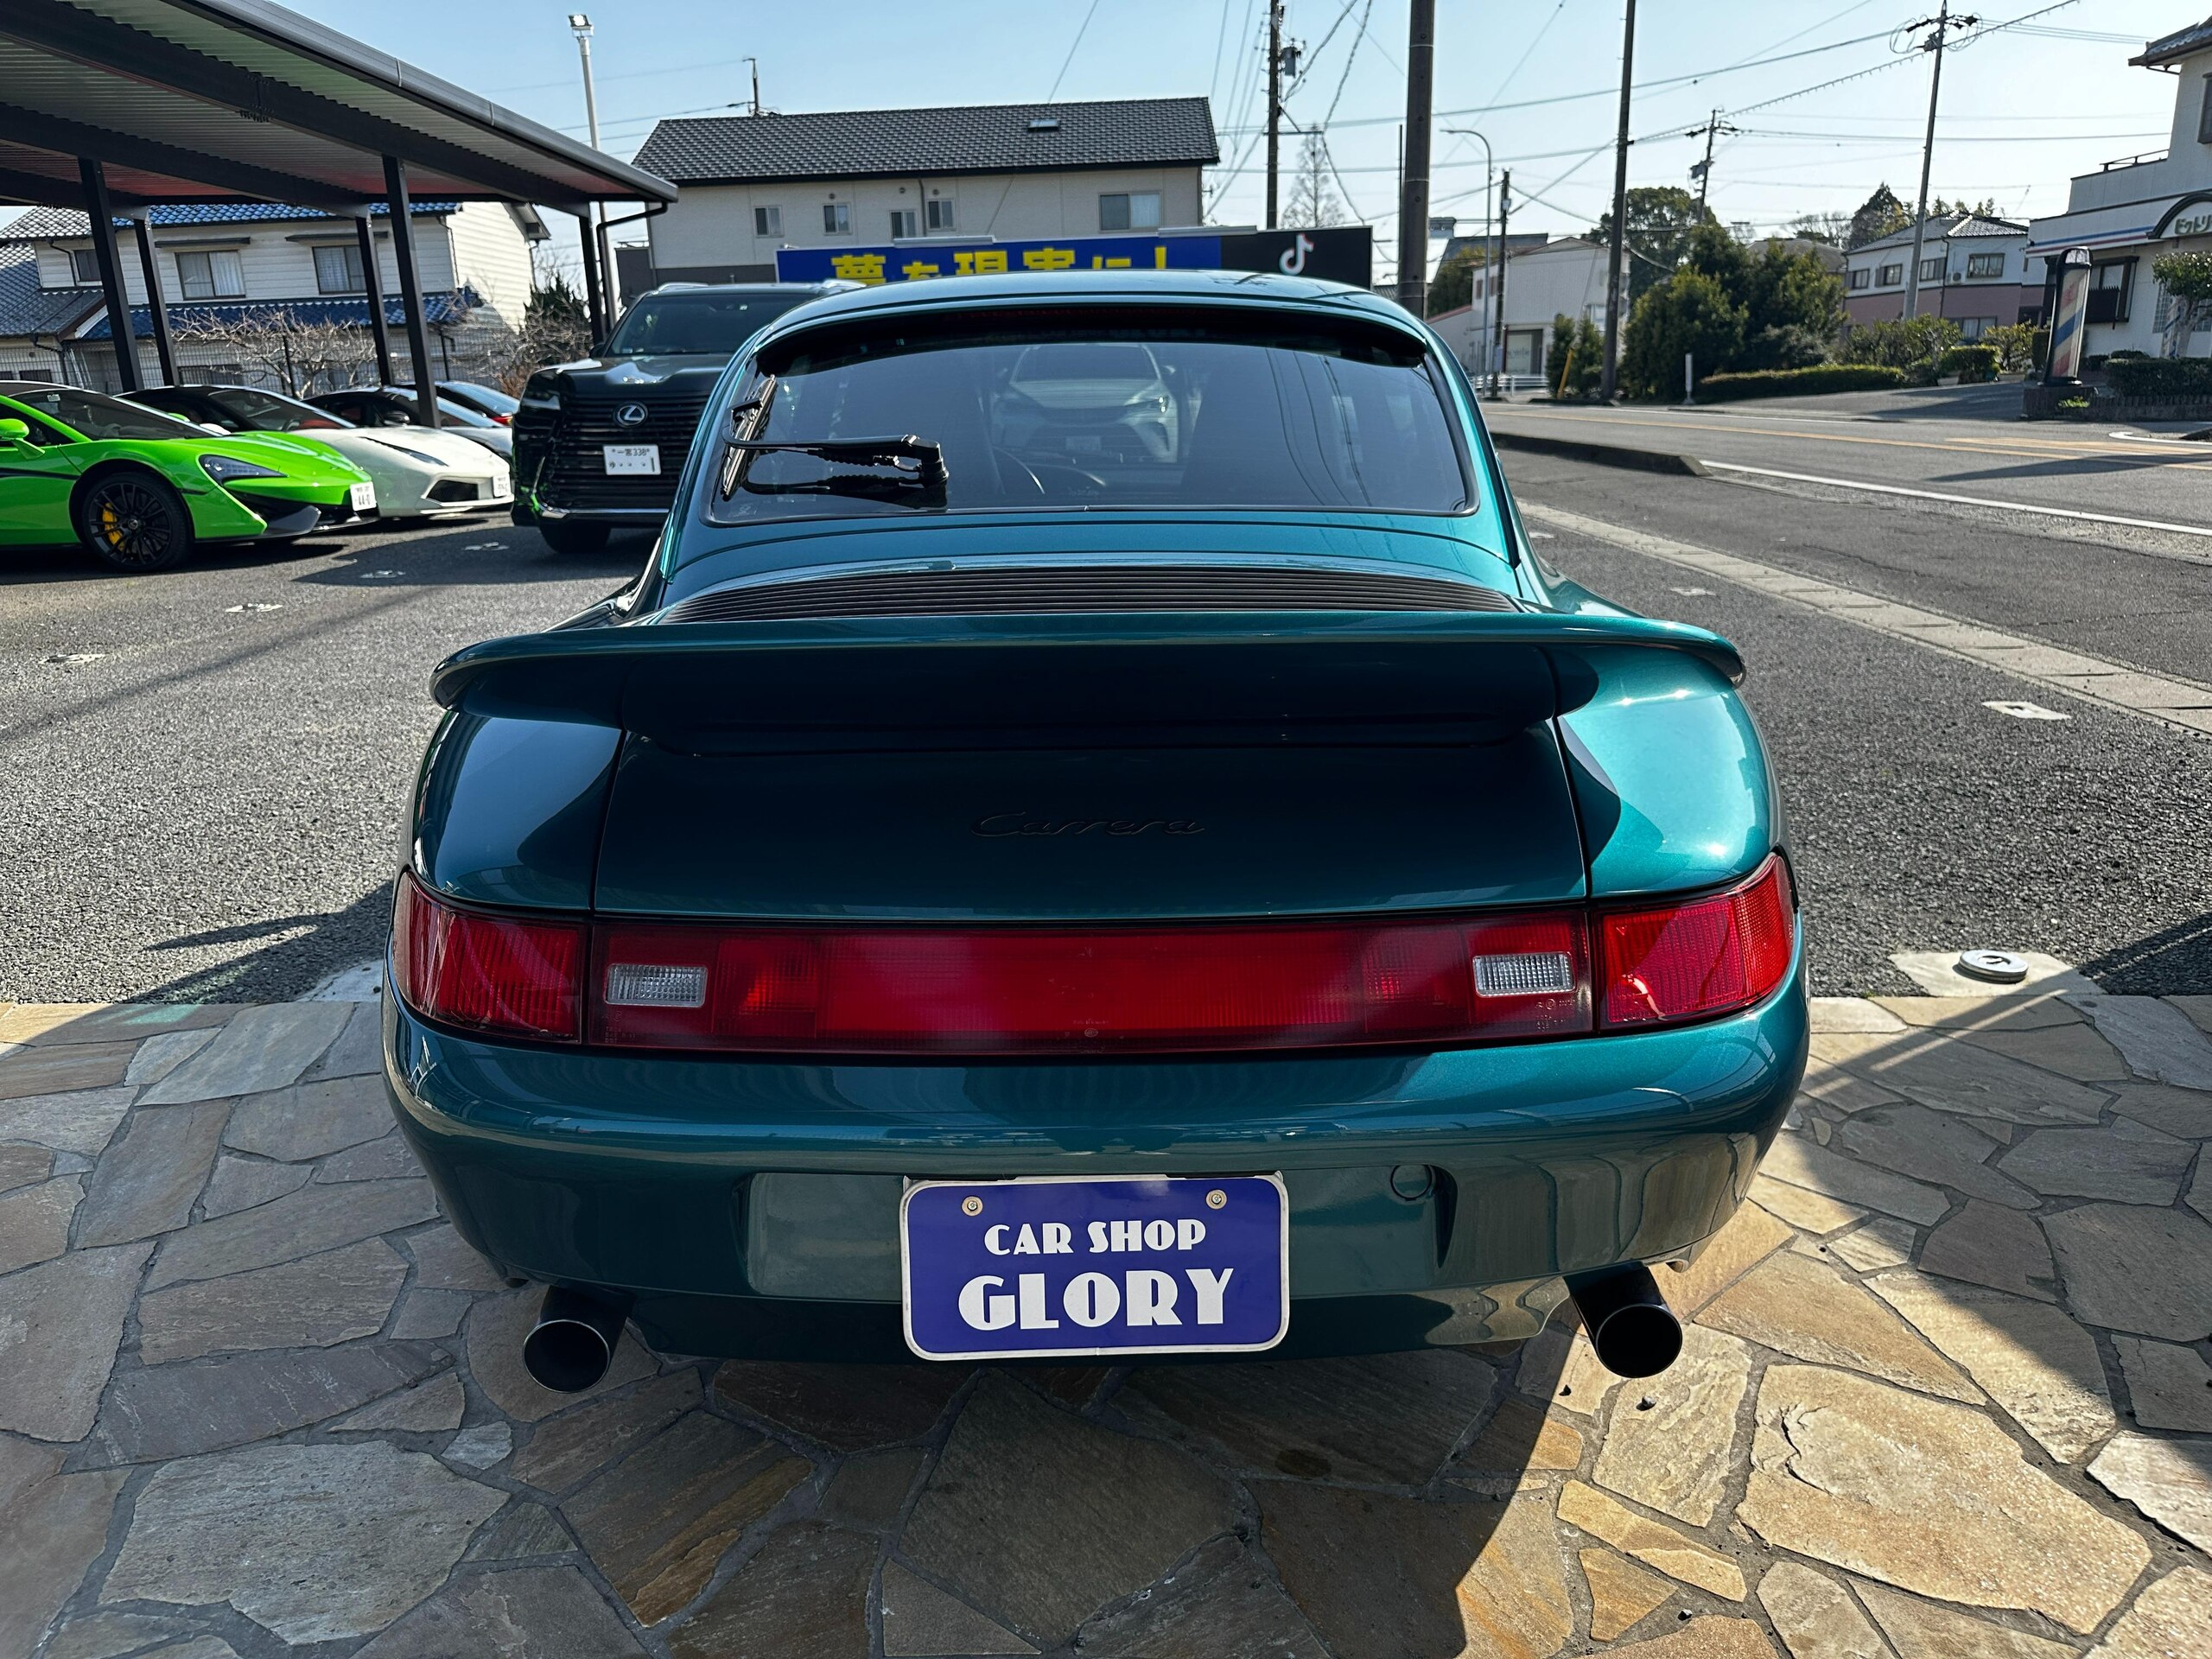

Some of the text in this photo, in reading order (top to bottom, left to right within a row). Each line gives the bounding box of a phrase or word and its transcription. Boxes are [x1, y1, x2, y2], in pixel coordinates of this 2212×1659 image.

[970, 811, 1205, 837] Carrera
[984, 1218, 1207, 1256] CAR SHOP
[957, 1267, 1235, 1332] GLORY
